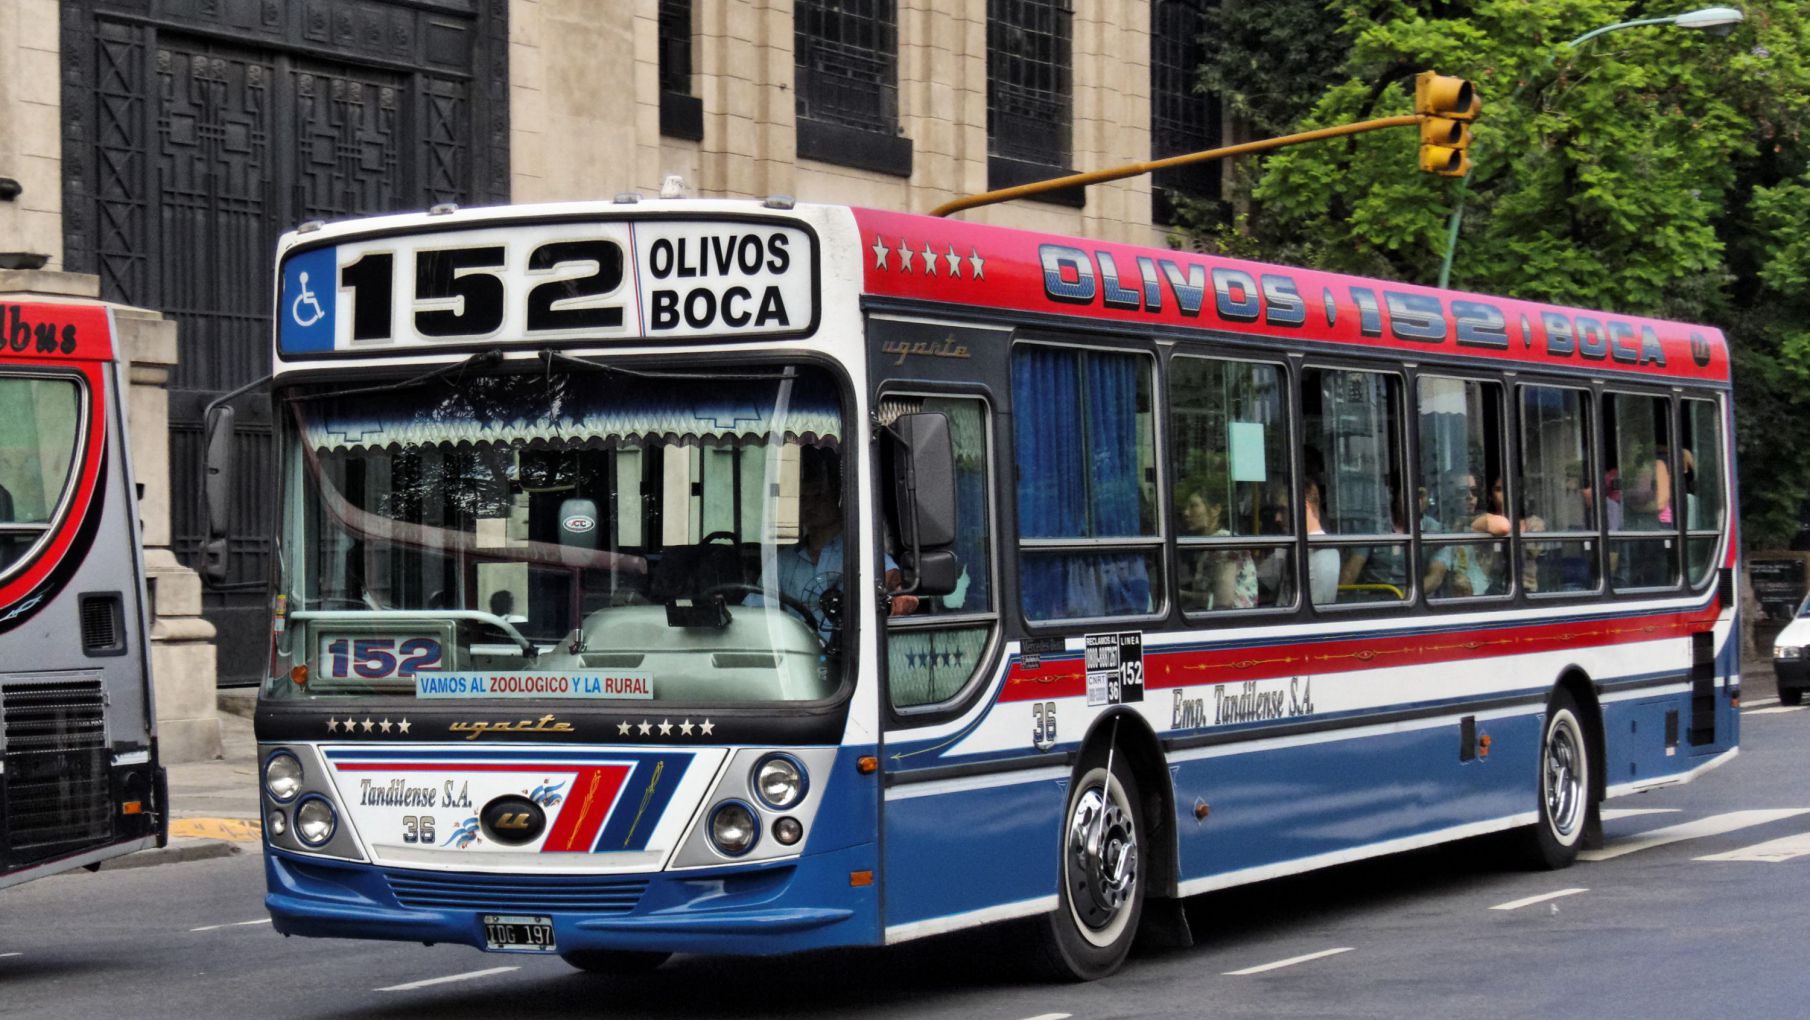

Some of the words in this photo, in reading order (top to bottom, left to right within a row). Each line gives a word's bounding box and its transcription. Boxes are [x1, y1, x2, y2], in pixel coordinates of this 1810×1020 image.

[649, 232, 791, 280] OLIVOS
[338, 239, 625, 342] 152
[1038, 243, 1306, 328] OLIVOS
[1348, 285, 1509, 350] 152
[1541, 311, 1667, 368] BOCA
[650, 284, 790, 331] BOCA
[1120, 636, 1139, 645] LINEA
[328, 637, 443, 679] 152
[1120, 660, 1143, 686] 152
[421, 677, 466, 694] VAMOS
[472, 677, 487, 693] AL
[489, 676, 569, 694] ZOOLOGICO
[572, 676, 581, 692] Y
[584, 676, 601, 693] LA
[605, 677, 649, 694] RURAL
[1108, 681, 1119, 700] 36
[1214, 680, 1285, 725] Tandilense
[449, 714, 575, 741] ugarte
[1032, 701, 1057, 743] 36
[360, 778, 436, 808] Tandilense
[441, 779, 472, 808] S.A.
[402, 815, 436, 844] 36
[523, 925, 550, 945] 197
